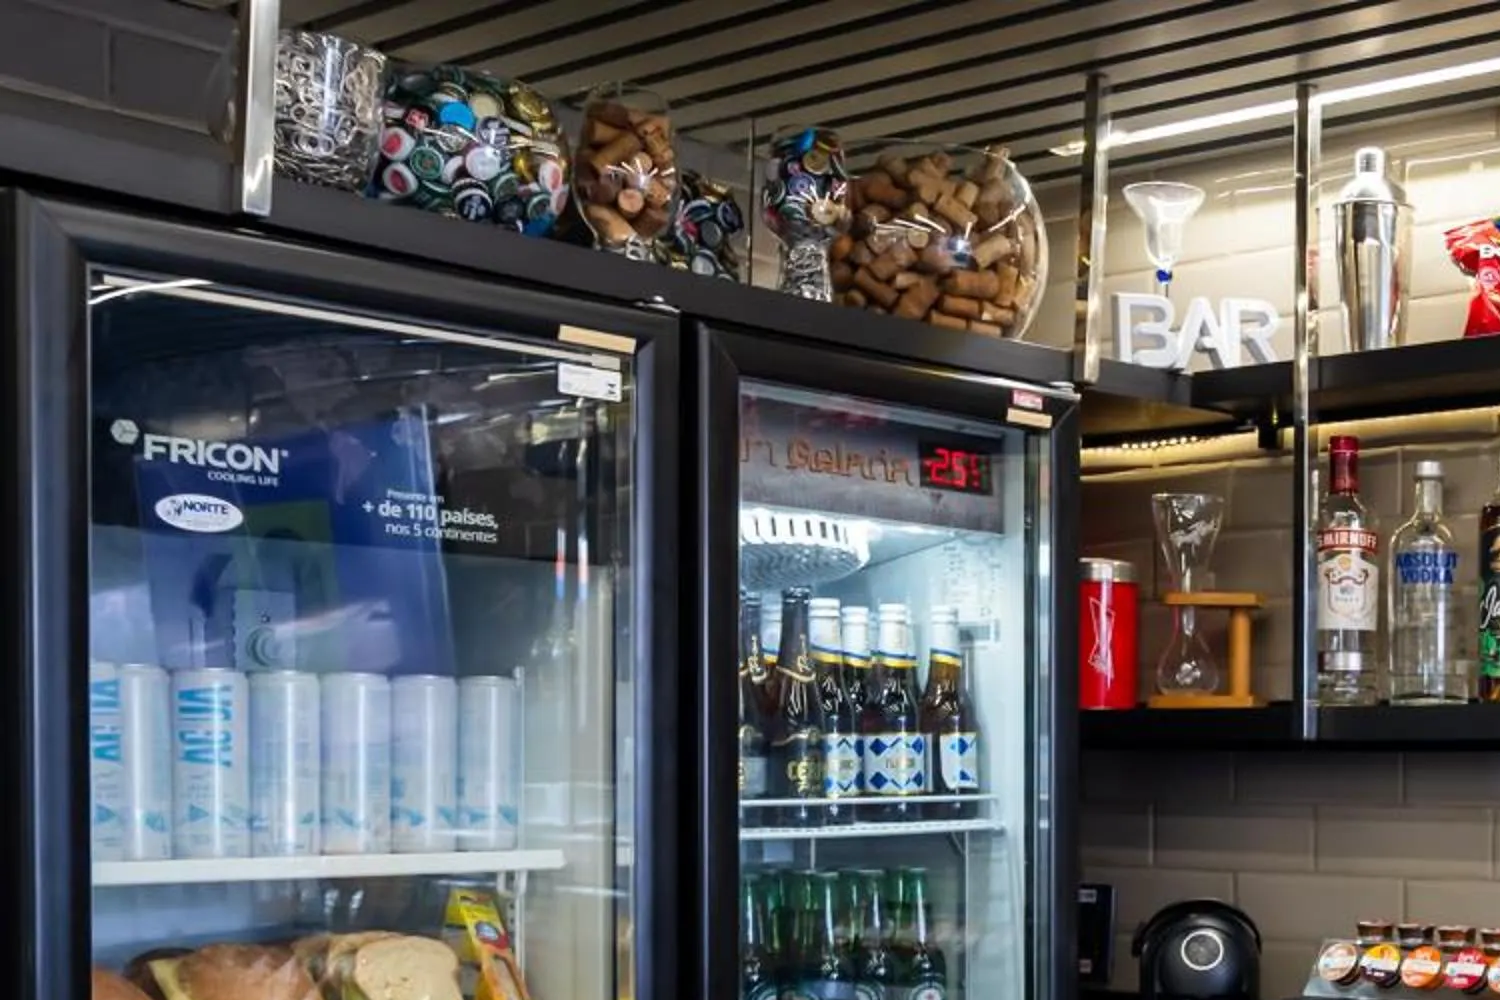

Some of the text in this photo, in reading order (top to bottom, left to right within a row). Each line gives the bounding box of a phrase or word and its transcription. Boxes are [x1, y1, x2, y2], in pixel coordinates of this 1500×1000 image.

[1111, 292, 1281, 374] BAR
[143, 433, 280, 474] FRICON
[207, 470, 279, 487] COOLING LIFE
[183, 499, 229, 515] NORTE
[378, 500, 402, 517] de
[406, 504, 436, 521] 110
[385, 523, 497, 543] nos 5 continentes
[1396, 551, 1458, 568] ABSOLUT
[1402, 568, 1453, 584] VODKA
